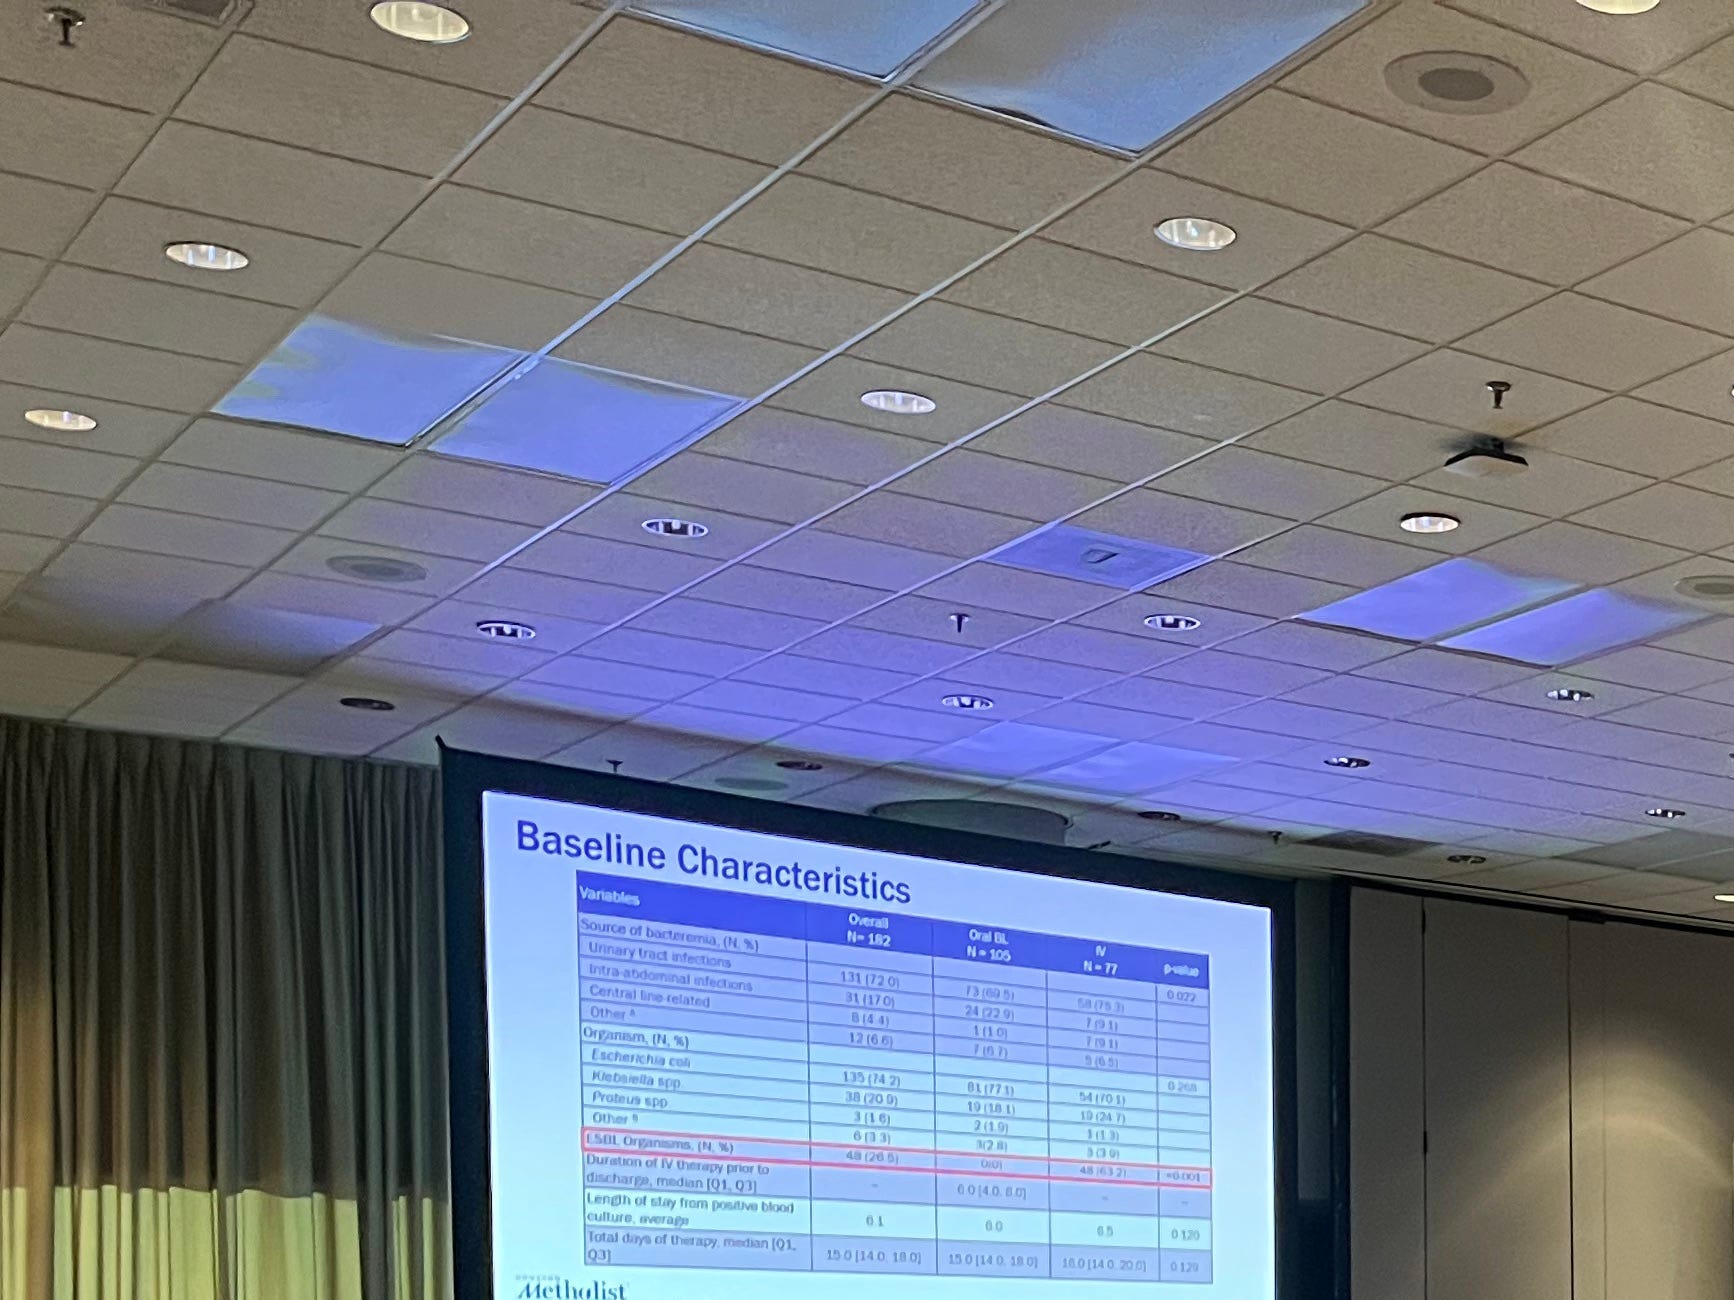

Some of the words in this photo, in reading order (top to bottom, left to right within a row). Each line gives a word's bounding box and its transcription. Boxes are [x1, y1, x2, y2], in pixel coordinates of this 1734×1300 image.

[517, 819, 666, 870] Baseline
[677, 844, 911, 904] Characteristics
[579, 885, 640, 906] Variables
[580, 917, 627, 936] Source
[630, 925, 642, 938] of
[849, 912, 889, 930] Overall
[969, 928, 992, 943] Oral
[588, 940, 635, 960] Urinary
[638, 946, 668, 962] tract
[671, 949, 732, 969] infections
[589, 983, 637, 1000] Central
[694, 972, 754, 993] infections
[590, 1005, 627, 1022] Other
[583, 1026, 649, 1045] Organism,
[591, 1047, 666, 1067] Escherichia
[669, 1056, 691, 1069] coli
[591, 1069, 655, 1087] Klebsiella
[592, 1090, 641, 1106] Proteus
[592, 1110, 629, 1125] Other
[586, 1153, 642, 1168] Duration
[645, 1156, 659, 1169] of
[661, 1157, 673, 1170] IV
[676, 1159, 724, 1175] therapy
[726, 1162, 755, 1176] prior
[757, 1164, 770, 1176] to
[586, 1171, 652, 1189] discharge,
[656, 1175, 704, 1190] median
[587, 1191, 631, 1208] Length
[634, 1194, 648, 1207] of
[650, 1196, 677, 1211] stay
[680, 1197, 709, 1211] from
[711, 1199, 759, 1213] positive
[761, 1202, 795, 1214] blood
[587, 1211, 636, 1225] culture,
[639, 1214, 689, 1230] average
[587, 1230, 619, 1244] Total
[622, 1232, 651, 1247] days
[654, 1234, 667, 1246] of
[723, 1237, 769, 1251] median
